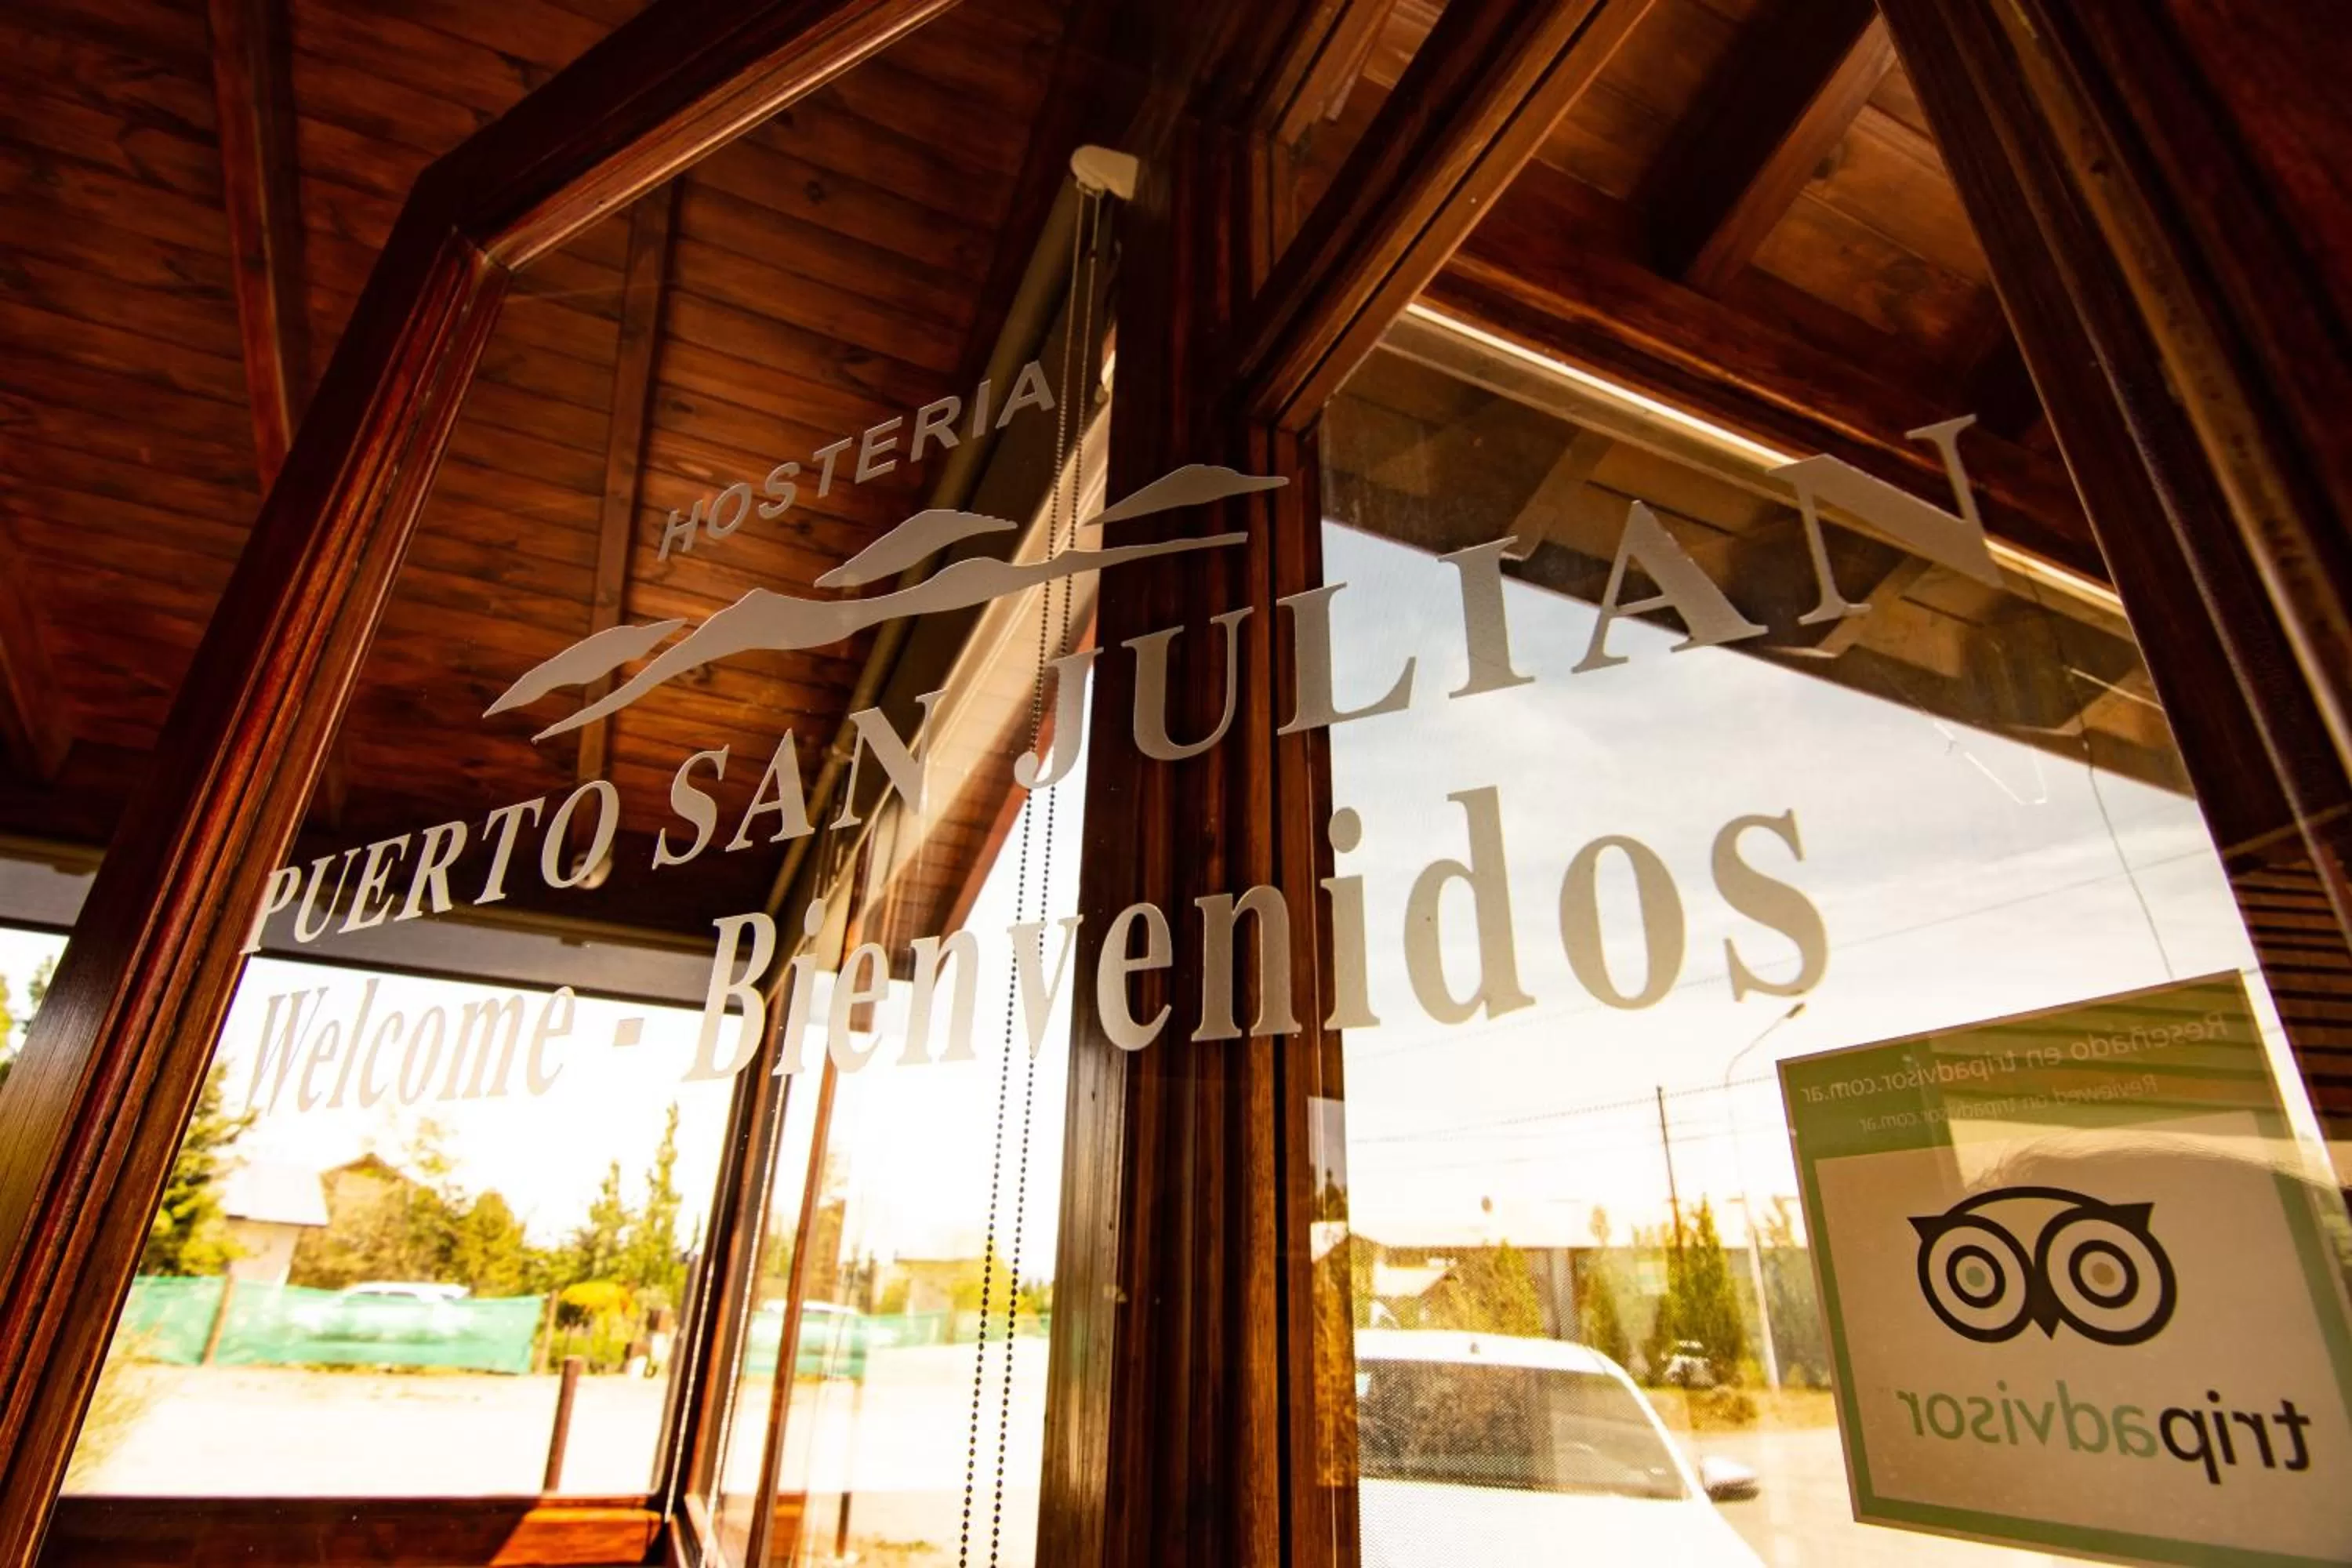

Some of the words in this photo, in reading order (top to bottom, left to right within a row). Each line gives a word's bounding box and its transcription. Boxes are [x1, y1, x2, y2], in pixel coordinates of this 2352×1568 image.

[657, 360, 1056, 562] HOSTERIA
[240, 780, 621, 956] PUERTO
[652, 688, 949, 869] SAN
[1014, 414, 2004, 790] JULIAN
[244, 978, 576, 1116] Welcome
[681, 785, 1830, 1083] Bienvenidos
